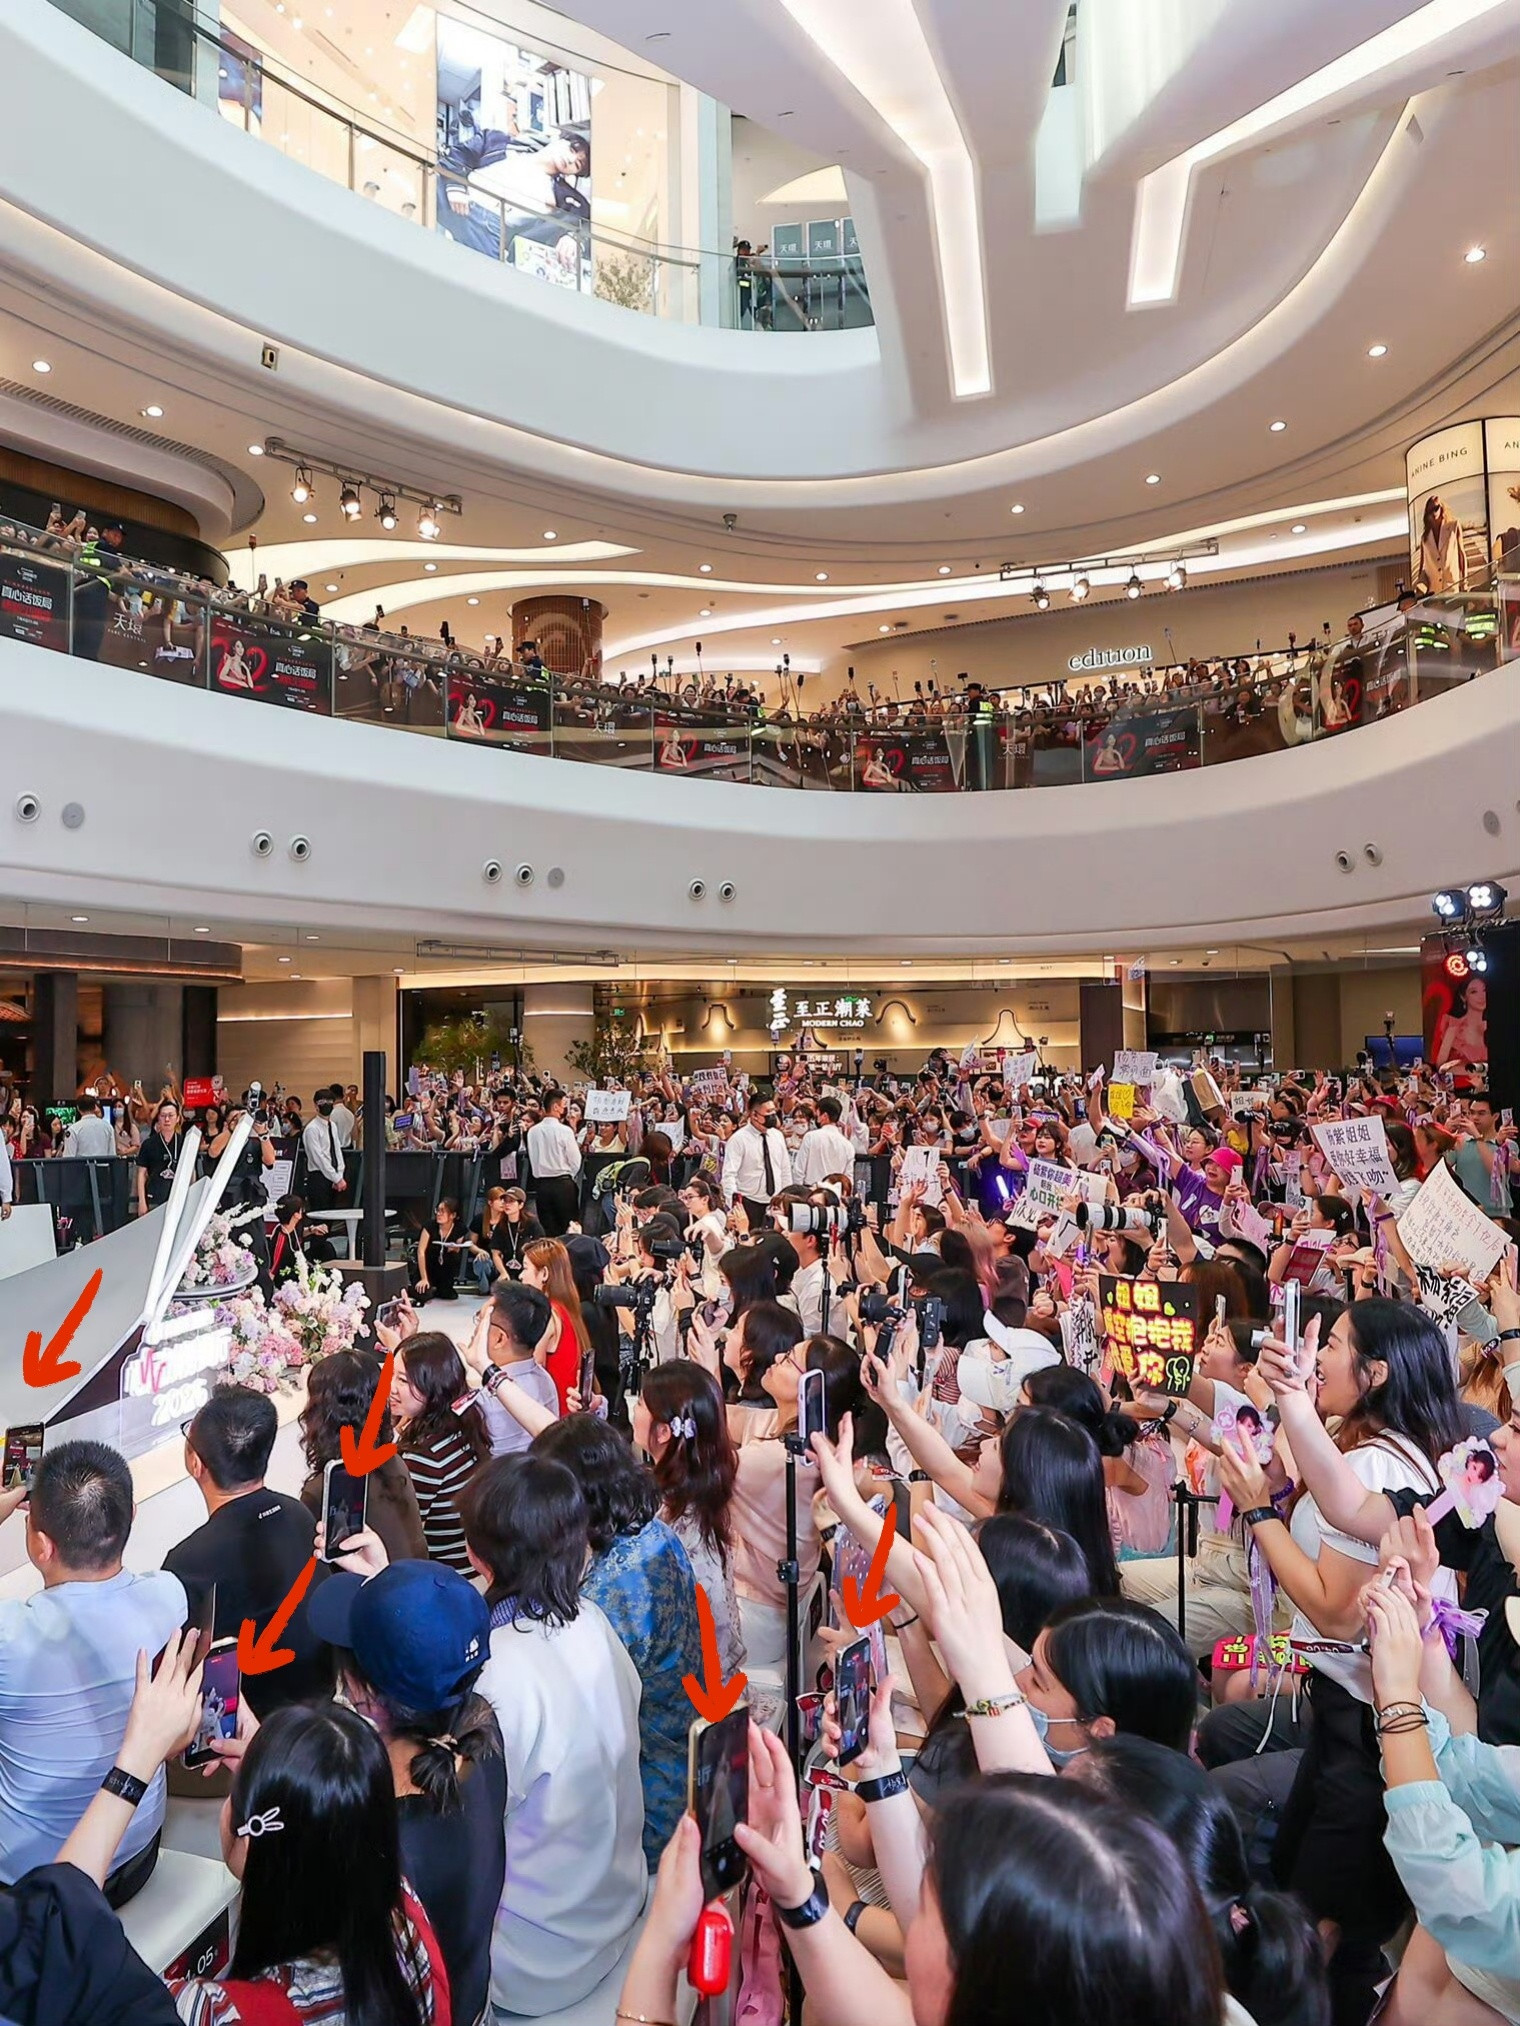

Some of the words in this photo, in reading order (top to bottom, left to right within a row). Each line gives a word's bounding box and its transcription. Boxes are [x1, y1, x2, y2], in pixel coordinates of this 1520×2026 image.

[1411, 458, 1435, 478] ANINE
[1439, 446, 1468, 463] BING
[793, 997, 873, 1019] 至正潮菜
[801, 1020, 838, 1028] MODERN
[839, 1020, 865, 1028] CHAO
